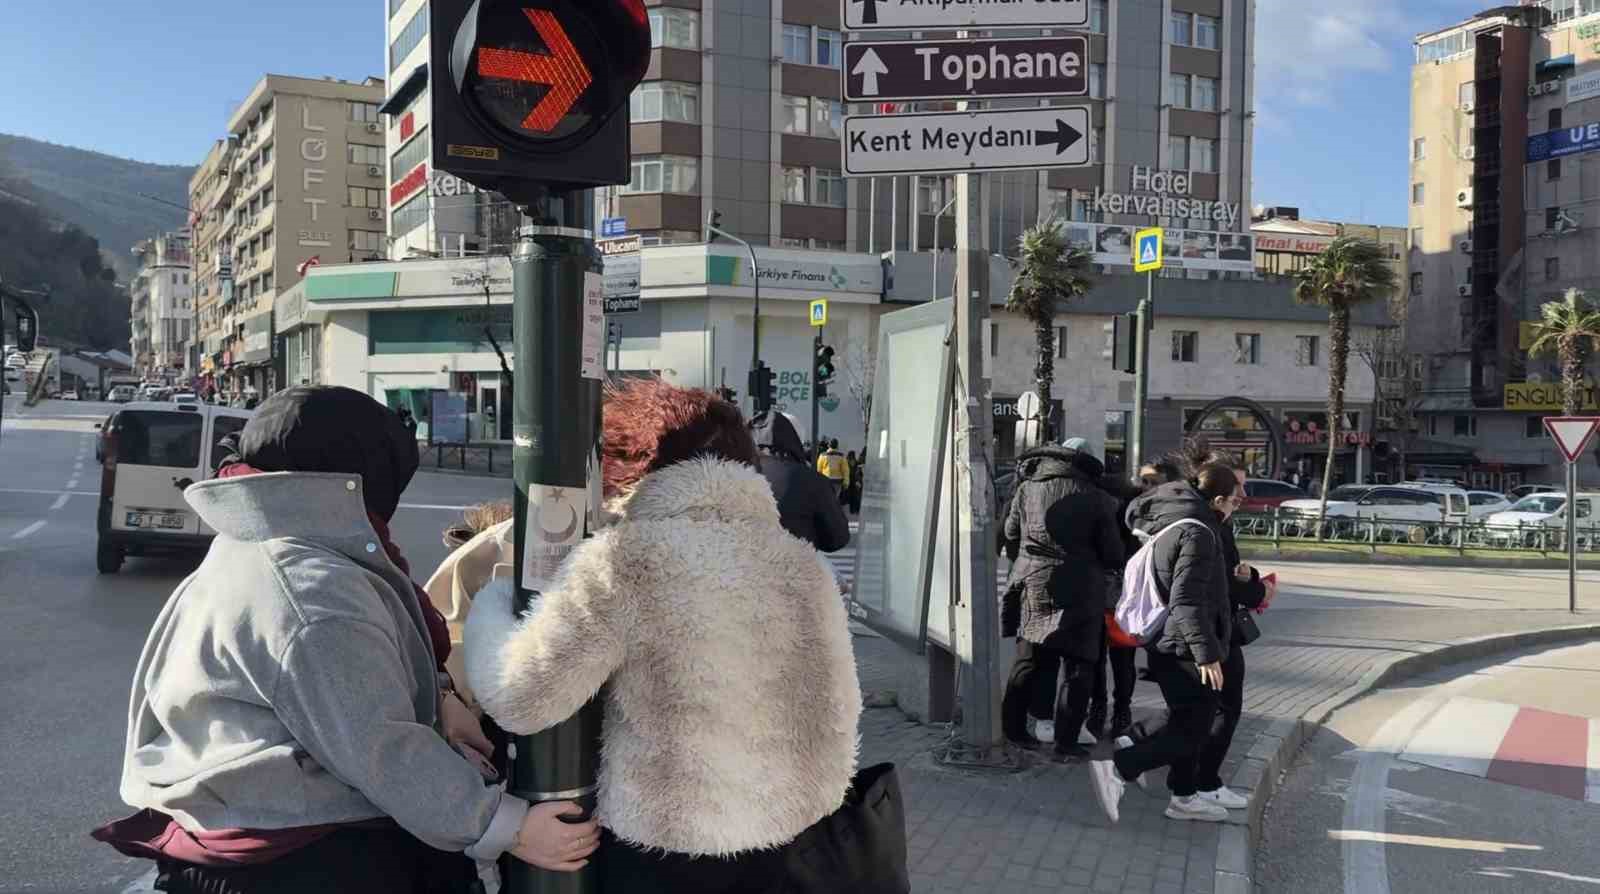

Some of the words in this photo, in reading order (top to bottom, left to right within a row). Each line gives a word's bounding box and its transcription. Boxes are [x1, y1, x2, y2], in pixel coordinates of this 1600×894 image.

[914, 45, 1081, 91] Tophane
[850, 130, 912, 153] Kent
[922, 125, 1031, 156] Meydanı
[1133, 164, 1192, 194] Hotel
[1094, 186, 1239, 228] kervansaray
[791, 270, 826, 282] Finans
[604, 298, 638, 311] Tophane
[779, 371, 811, 385] BOL
